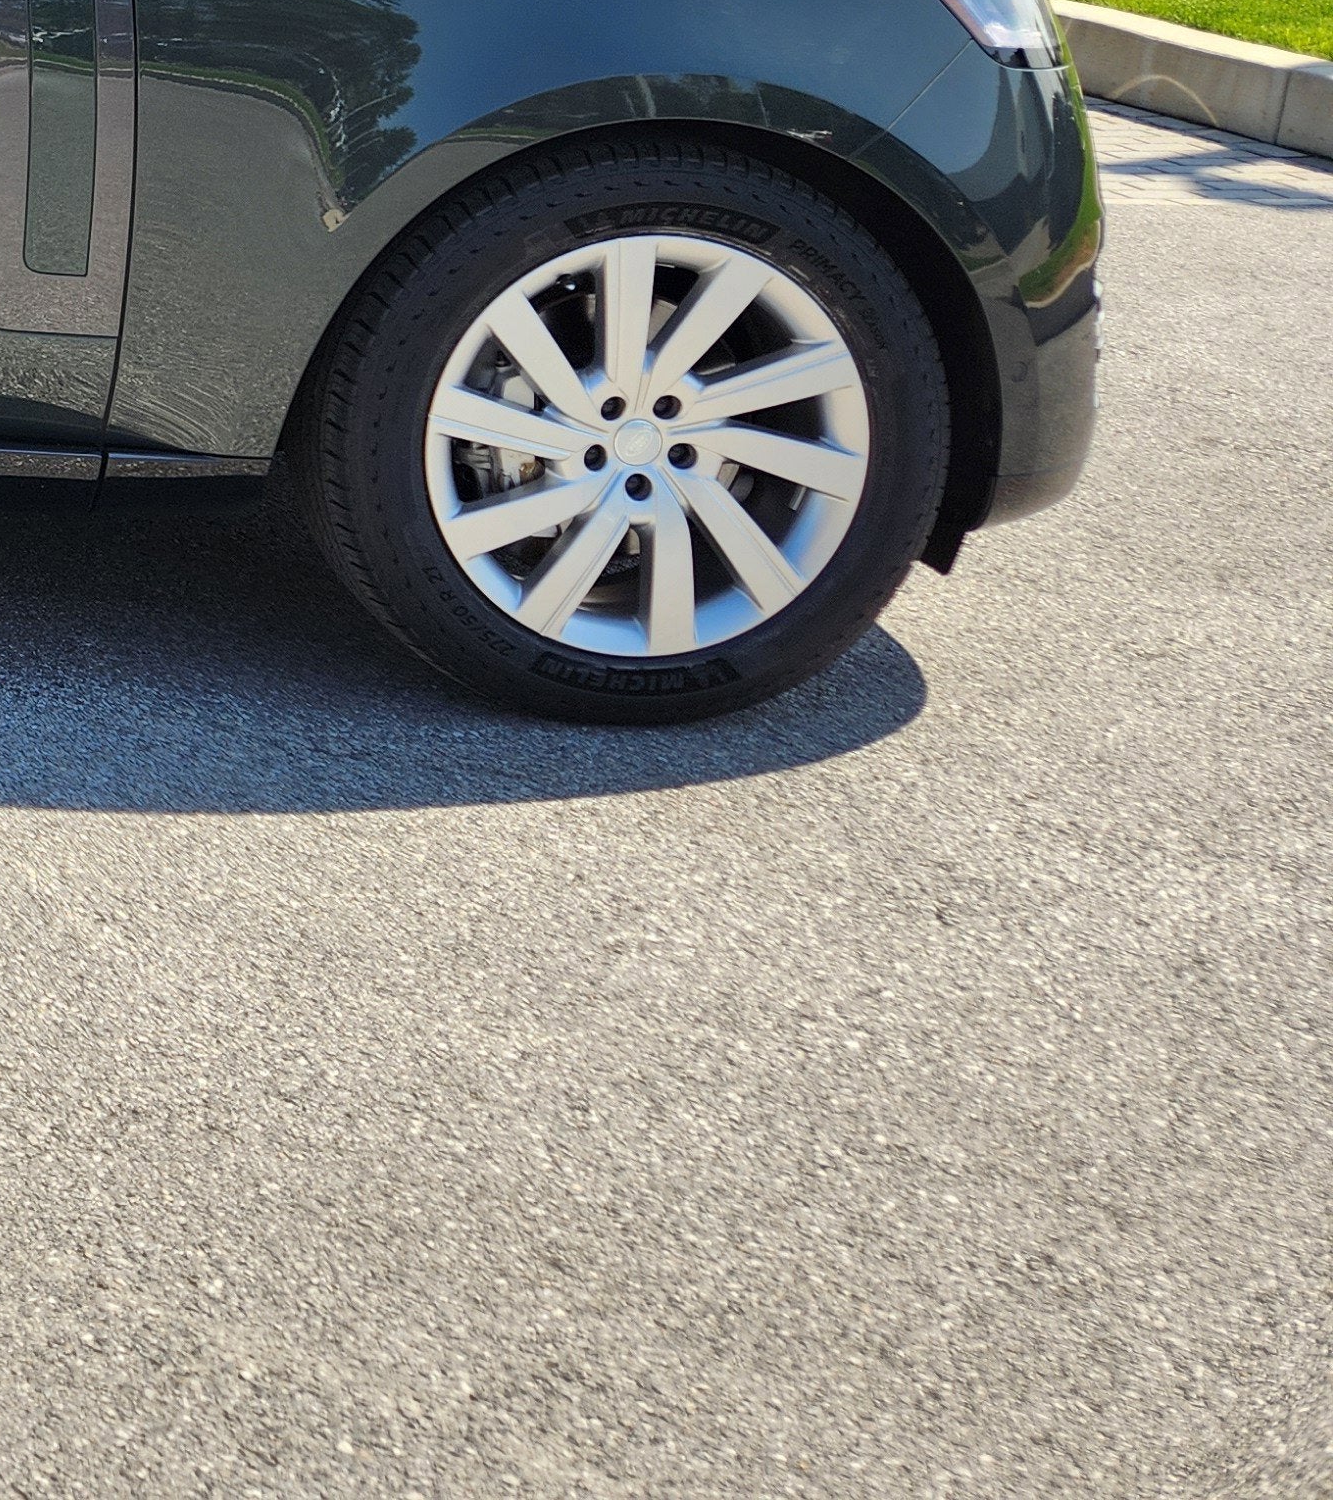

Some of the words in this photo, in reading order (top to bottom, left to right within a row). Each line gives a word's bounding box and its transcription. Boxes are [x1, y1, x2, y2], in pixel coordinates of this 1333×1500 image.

[620, 206, 768, 240] MICHELIN
[789, 238, 866, 301] PRIMACY
[541, 659, 685, 692] MICHELIN
